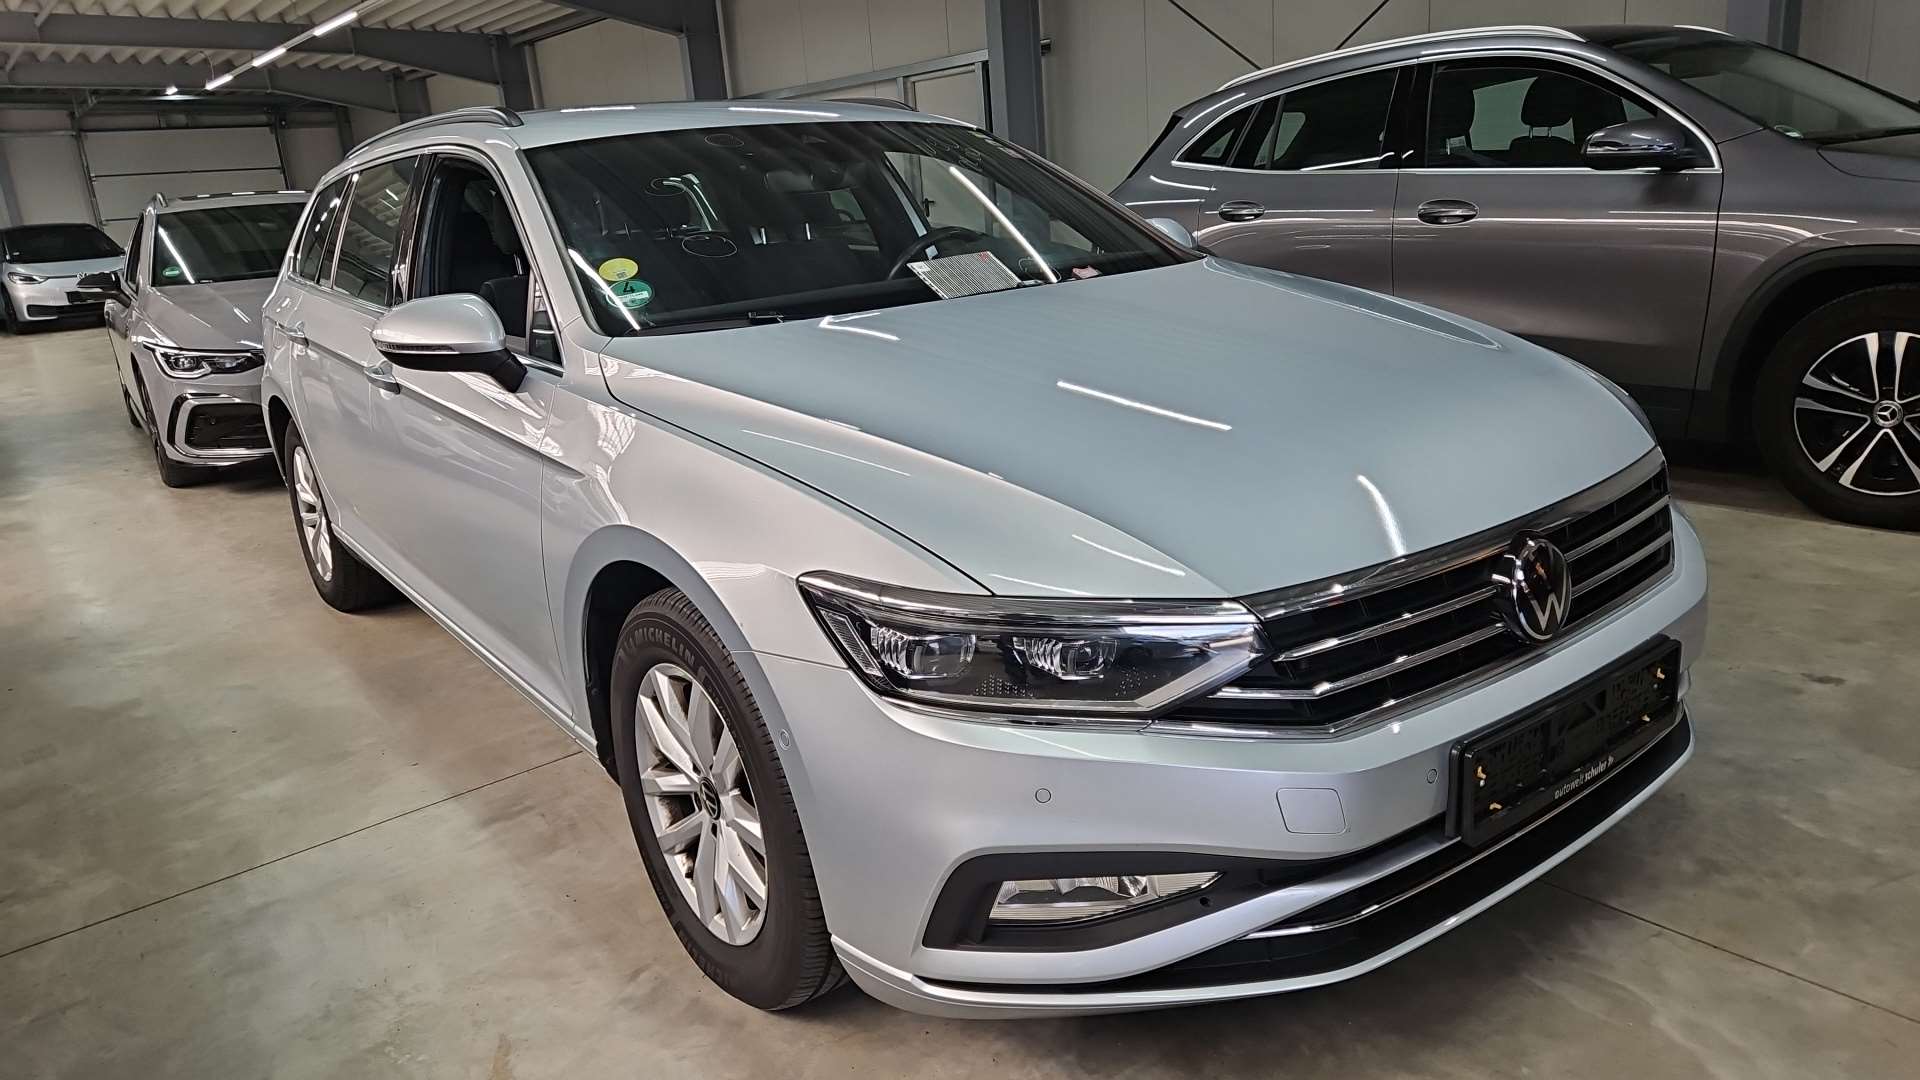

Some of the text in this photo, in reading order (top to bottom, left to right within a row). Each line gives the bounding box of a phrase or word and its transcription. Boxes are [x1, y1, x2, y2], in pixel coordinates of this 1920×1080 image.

[623, 280, 636, 294] 4
[634, 626, 696, 667] MICHELIN
[1554, 760, 1607, 800] autowelt schuler
